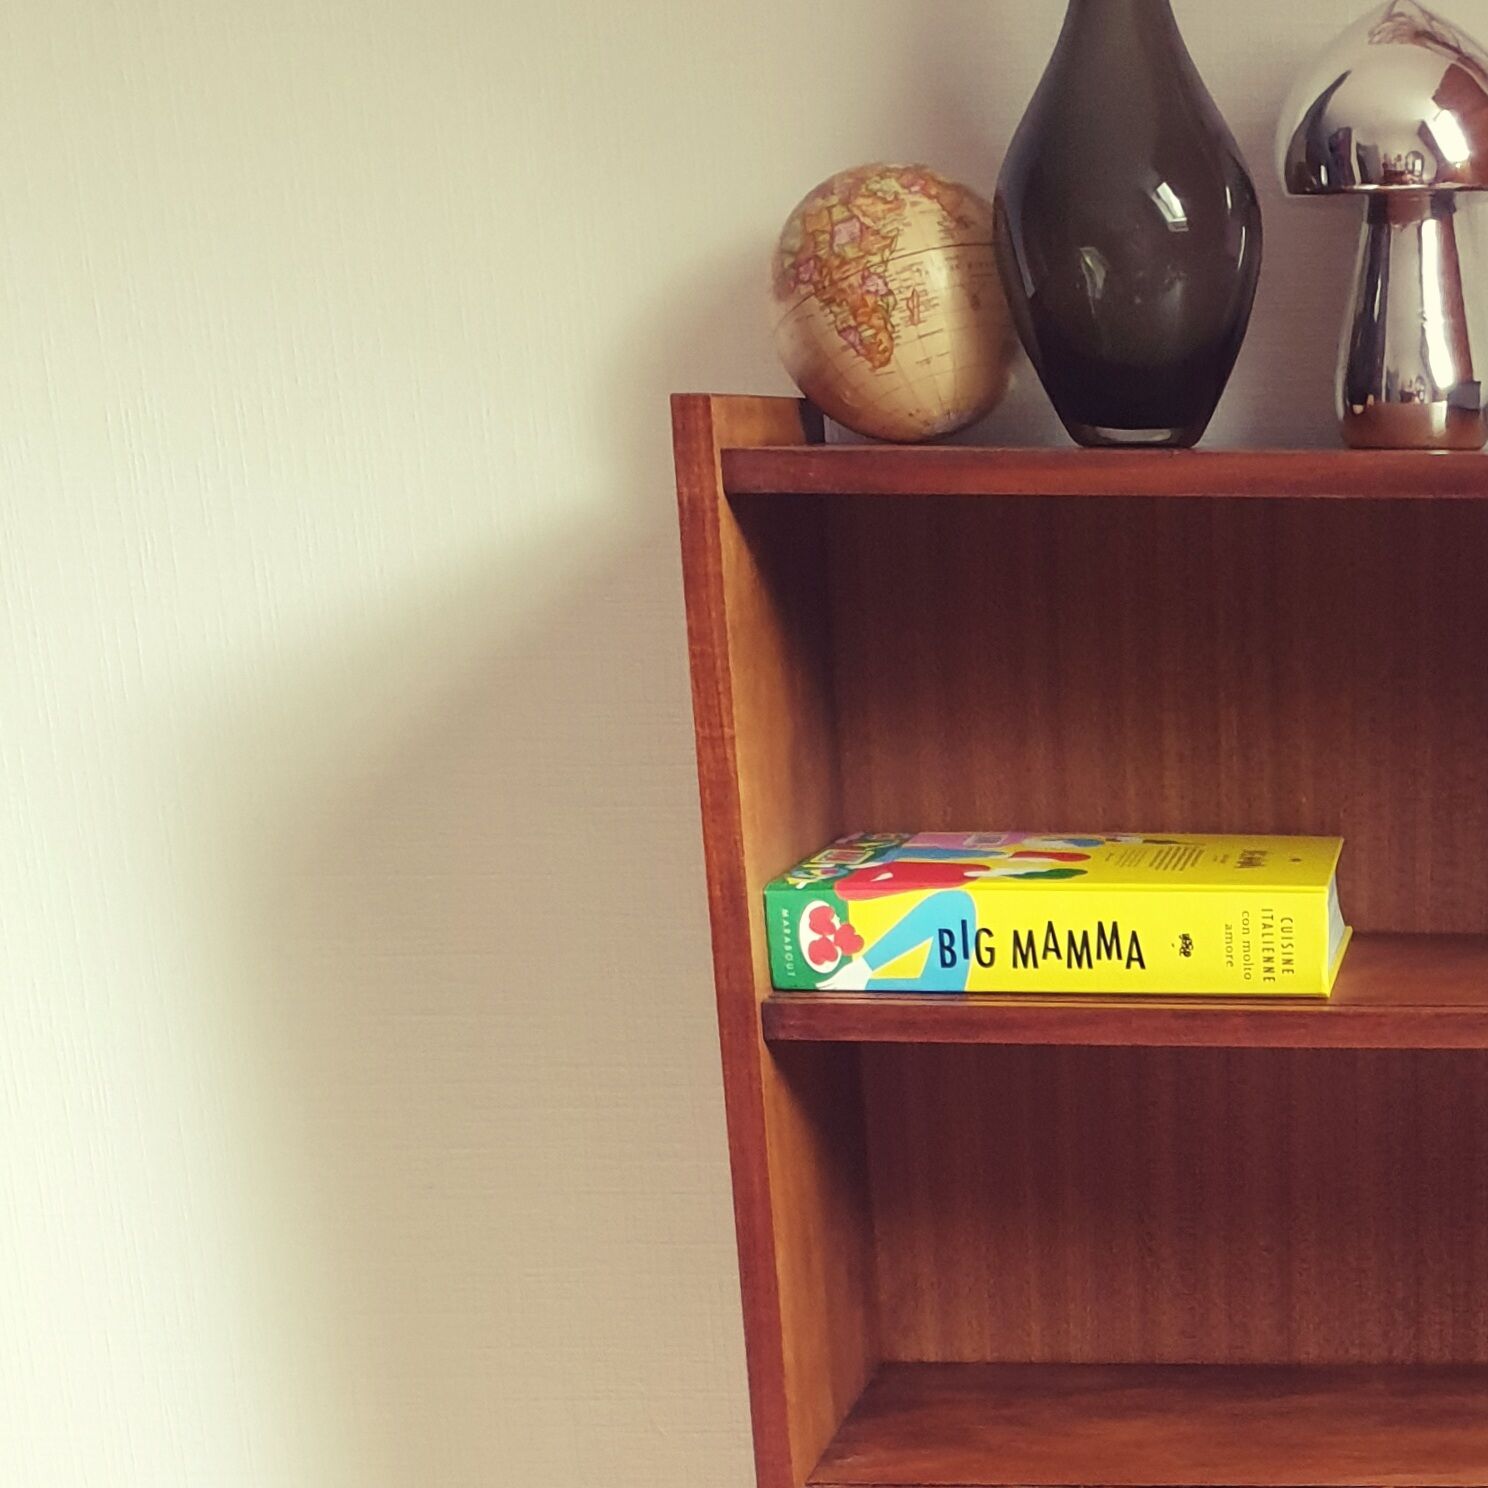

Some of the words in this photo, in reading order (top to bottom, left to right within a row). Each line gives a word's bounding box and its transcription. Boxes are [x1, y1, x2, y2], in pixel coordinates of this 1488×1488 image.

[782, 908, 796, 976] MARABOUT
[938, 919, 996, 969] BIG
[1012, 920, 1146, 970] MAMMA
[1225, 924, 1234, 968] amore
[1242, 910, 1250, 935] con
[1261, 908, 1276, 982] ITALIENNE
[1280, 917, 1294, 974] CUISINE
[1242, 940, 1255, 980] molto
